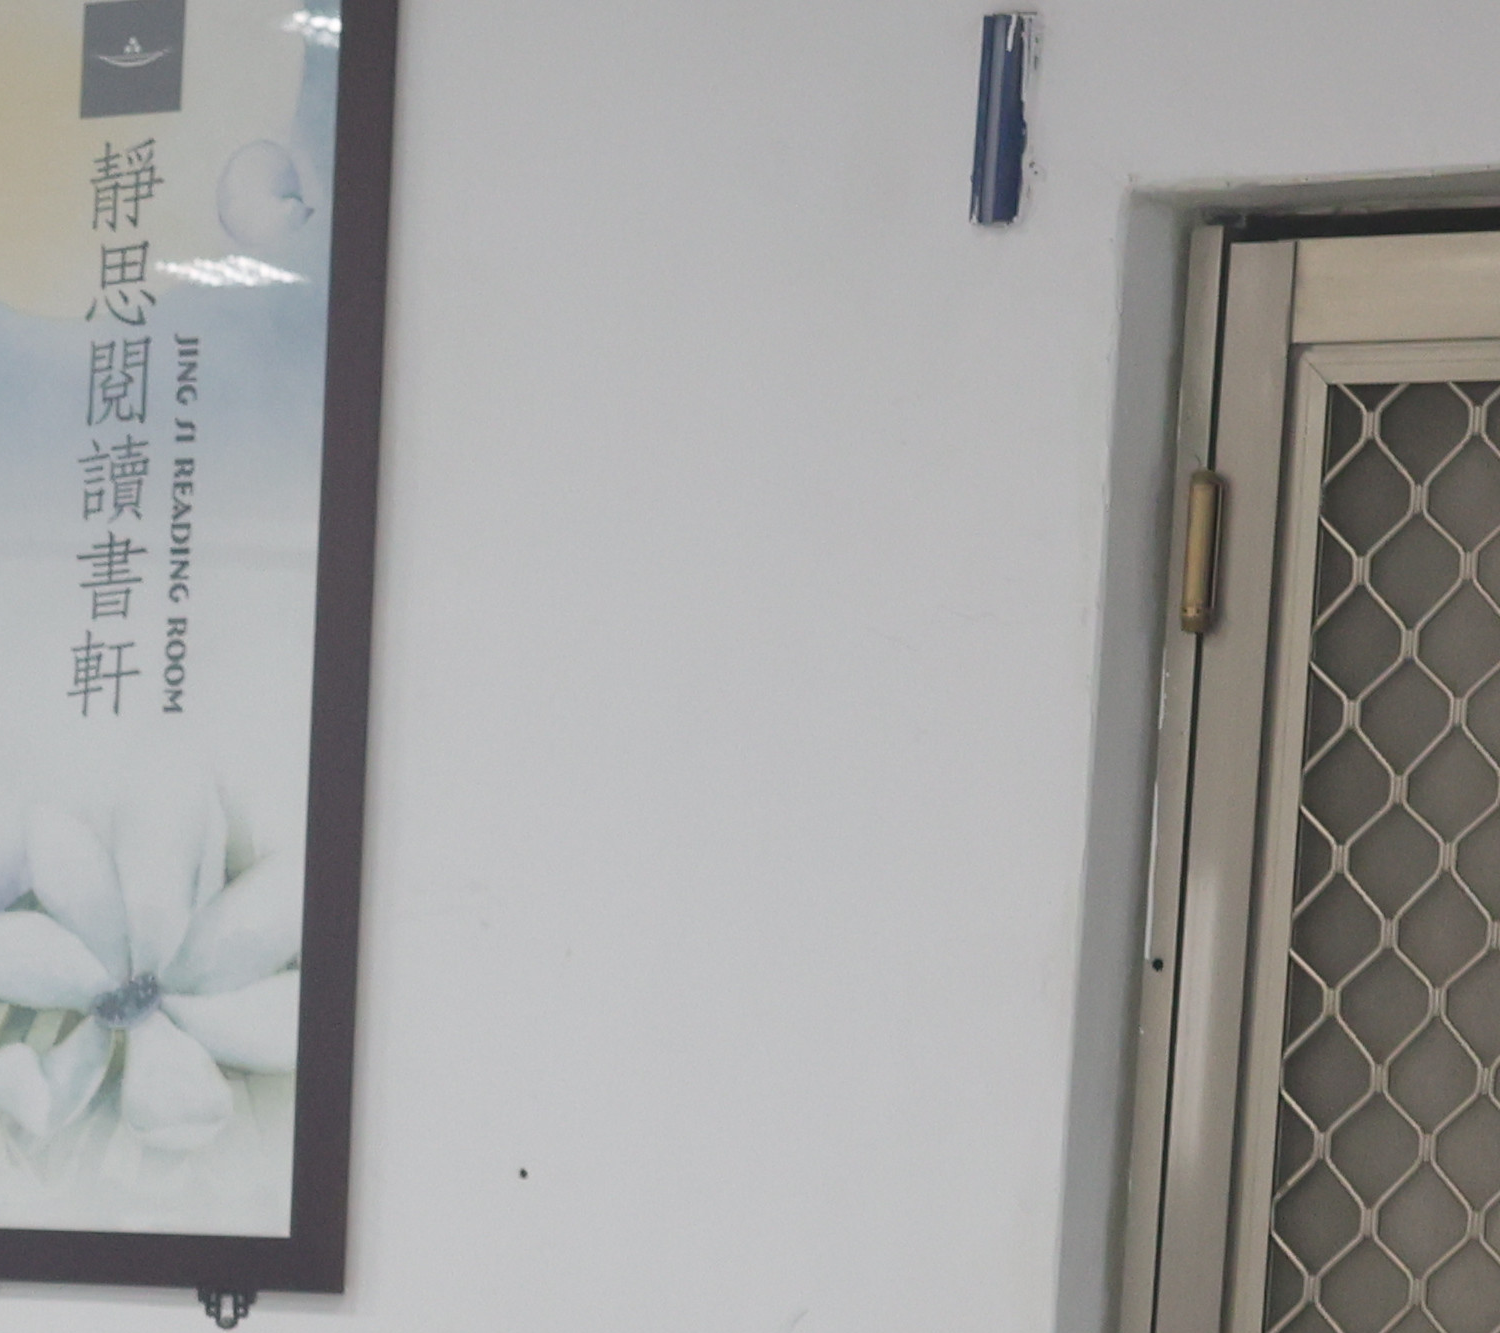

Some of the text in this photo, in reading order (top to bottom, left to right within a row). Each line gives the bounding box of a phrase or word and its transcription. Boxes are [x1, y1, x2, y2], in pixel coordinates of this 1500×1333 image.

[66, 138, 164, 717] 靜思閱讀書軒
[174, 333, 199, 405] JING
[169, 457, 196, 604] READING
[162, 616, 188, 715] ROOM
